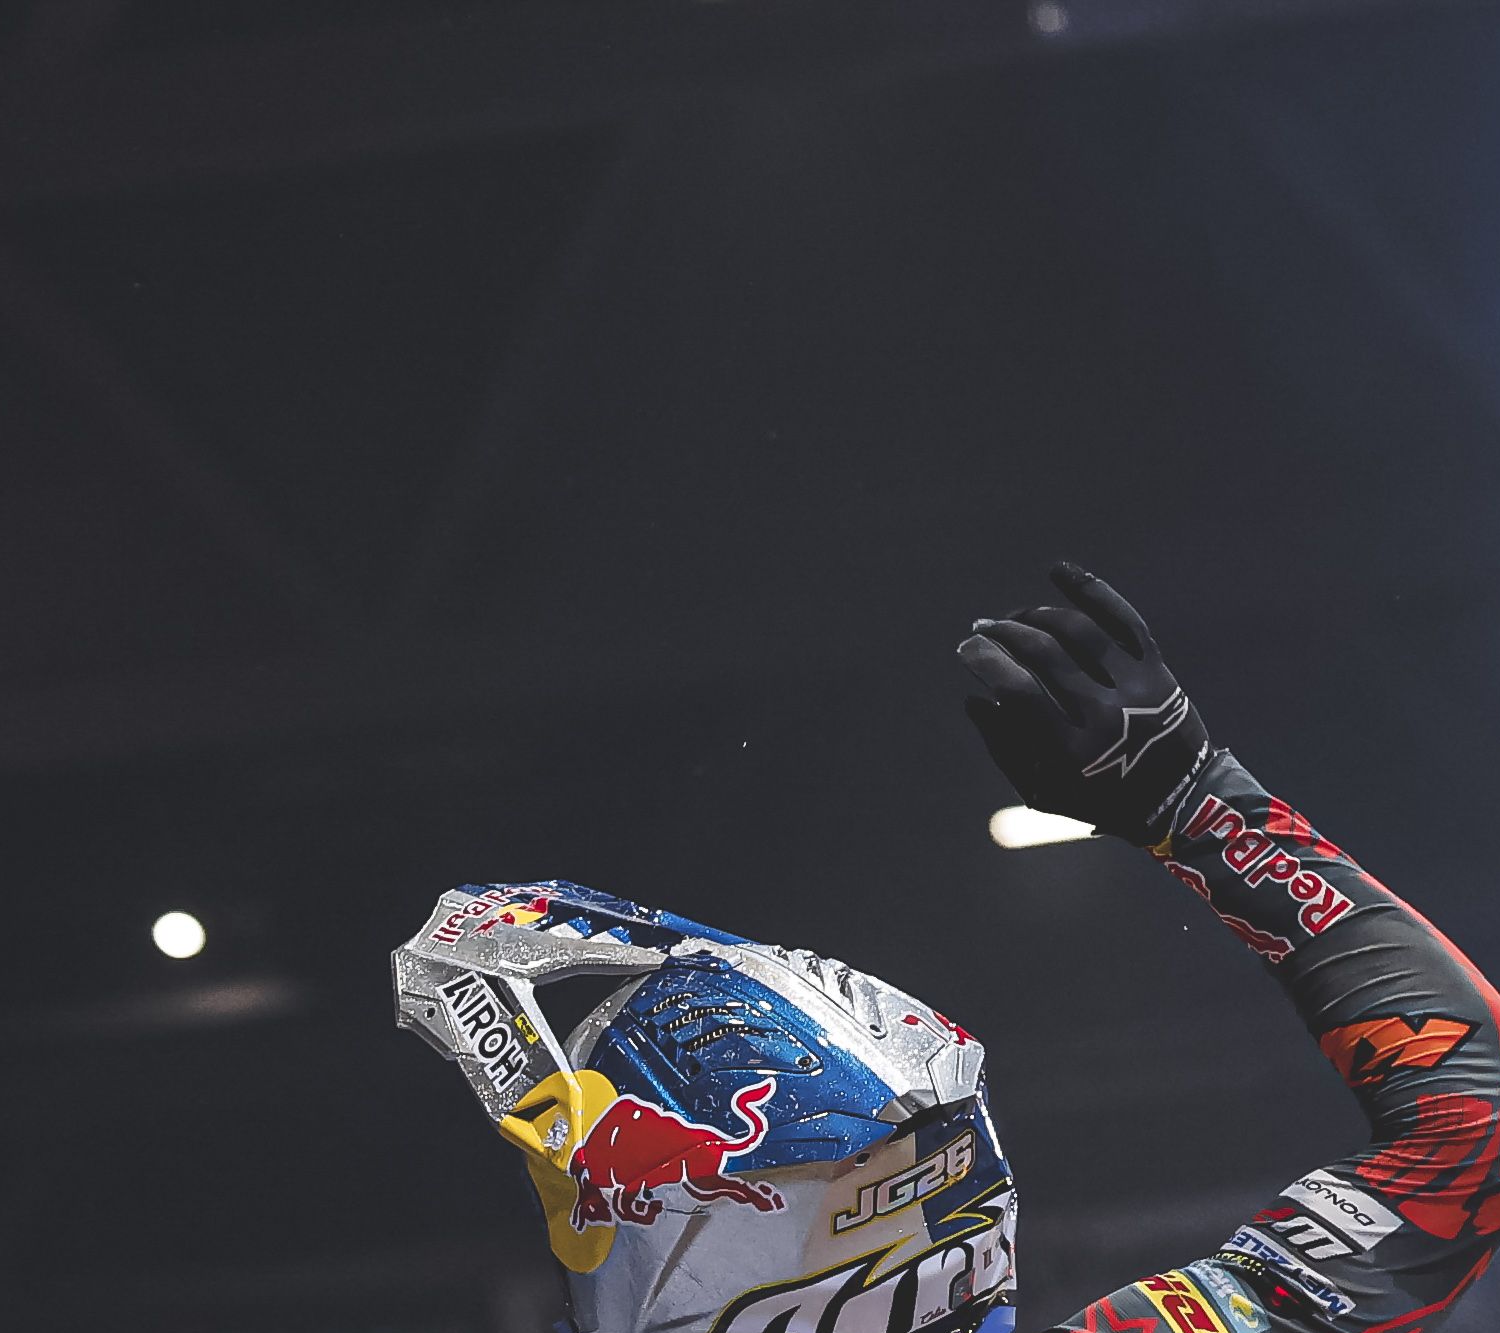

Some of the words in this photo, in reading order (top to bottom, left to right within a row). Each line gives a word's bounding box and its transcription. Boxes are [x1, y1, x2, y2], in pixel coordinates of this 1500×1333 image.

[1180, 794, 1276, 875] Bull
[1244, 848, 1356, 937] Red
[437, 971, 528, 1092] AIROH
[836, 1133, 973, 1234] JG26
[1296, 1178, 1377, 1228] DONJOY
[1229, 1230, 1349, 1316] METZELE
